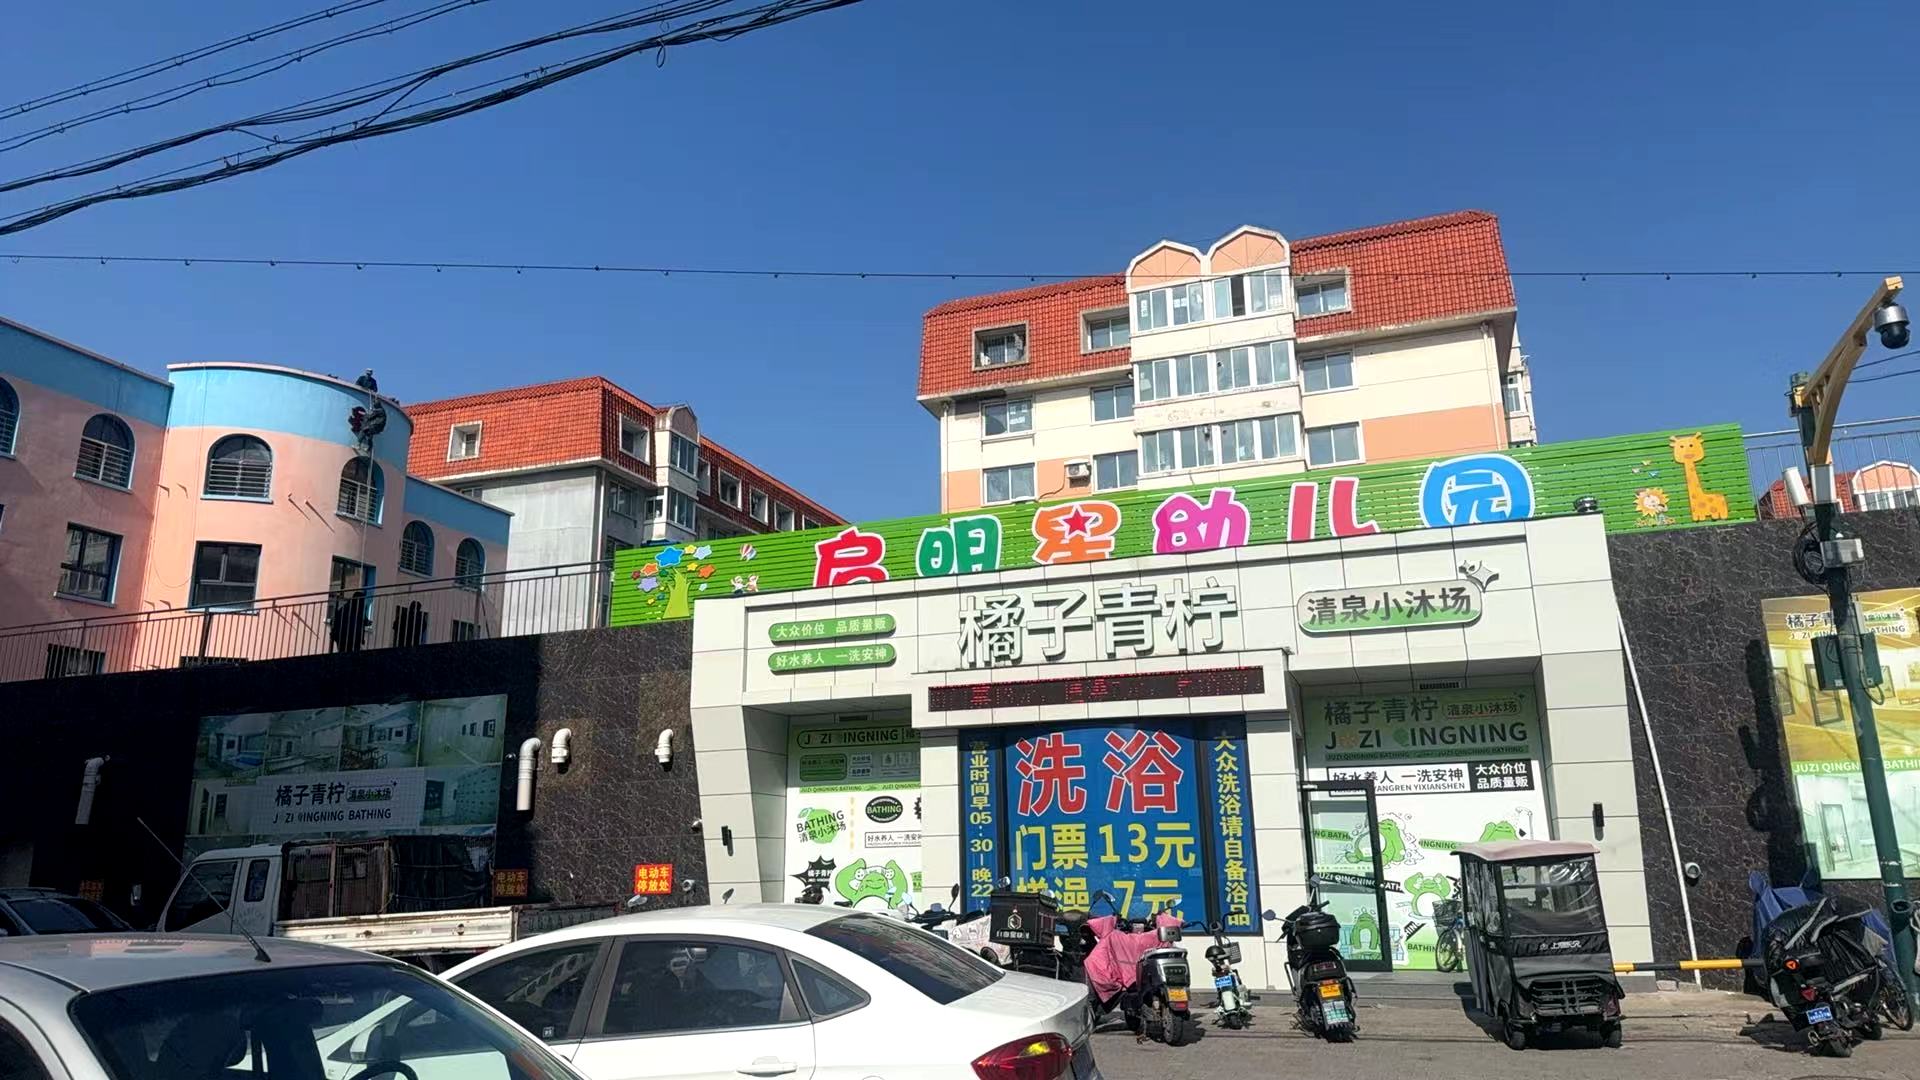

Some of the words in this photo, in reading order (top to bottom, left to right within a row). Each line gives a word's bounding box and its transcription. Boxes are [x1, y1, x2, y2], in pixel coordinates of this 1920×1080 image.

[813, 453, 1536, 587] 启明星幼儿园
[1306, 586, 1472, 626] 清泉小沐场
[776, 622, 826, 638] 大众价位
[835, 617, 887, 634] 品质量贩
[958, 575, 1239, 668] 橘子青柠
[1866, 624, 1906, 634] ATHING
[775, 652, 825, 668] 好水养人
[835, 647, 888, 662] 一洗安神
[1323, 695, 1439, 726] 橘子青柠
[1015, 729, 1184, 817] 洗浴
[1400, 767, 1464, 783] 一洗安神
[1474, 762, 1528, 777] 大众价位
[1793, 763, 1820, 773] JUZI
[1821, 761, 1860, 774] QINGN
[274, 781, 345, 807] 橘子青柠
[347, 808, 392, 821] BATHING
[866, 804, 902, 814] BATHING
[796, 809, 845, 833] BATHING
[496, 871, 527, 884] 电动车
[638, 866, 671, 879] 电动车
[495, 882, 527, 897] 停放处
[636, 879, 671, 893] 停放处
[1113, 879, 1185, 922] 7元
